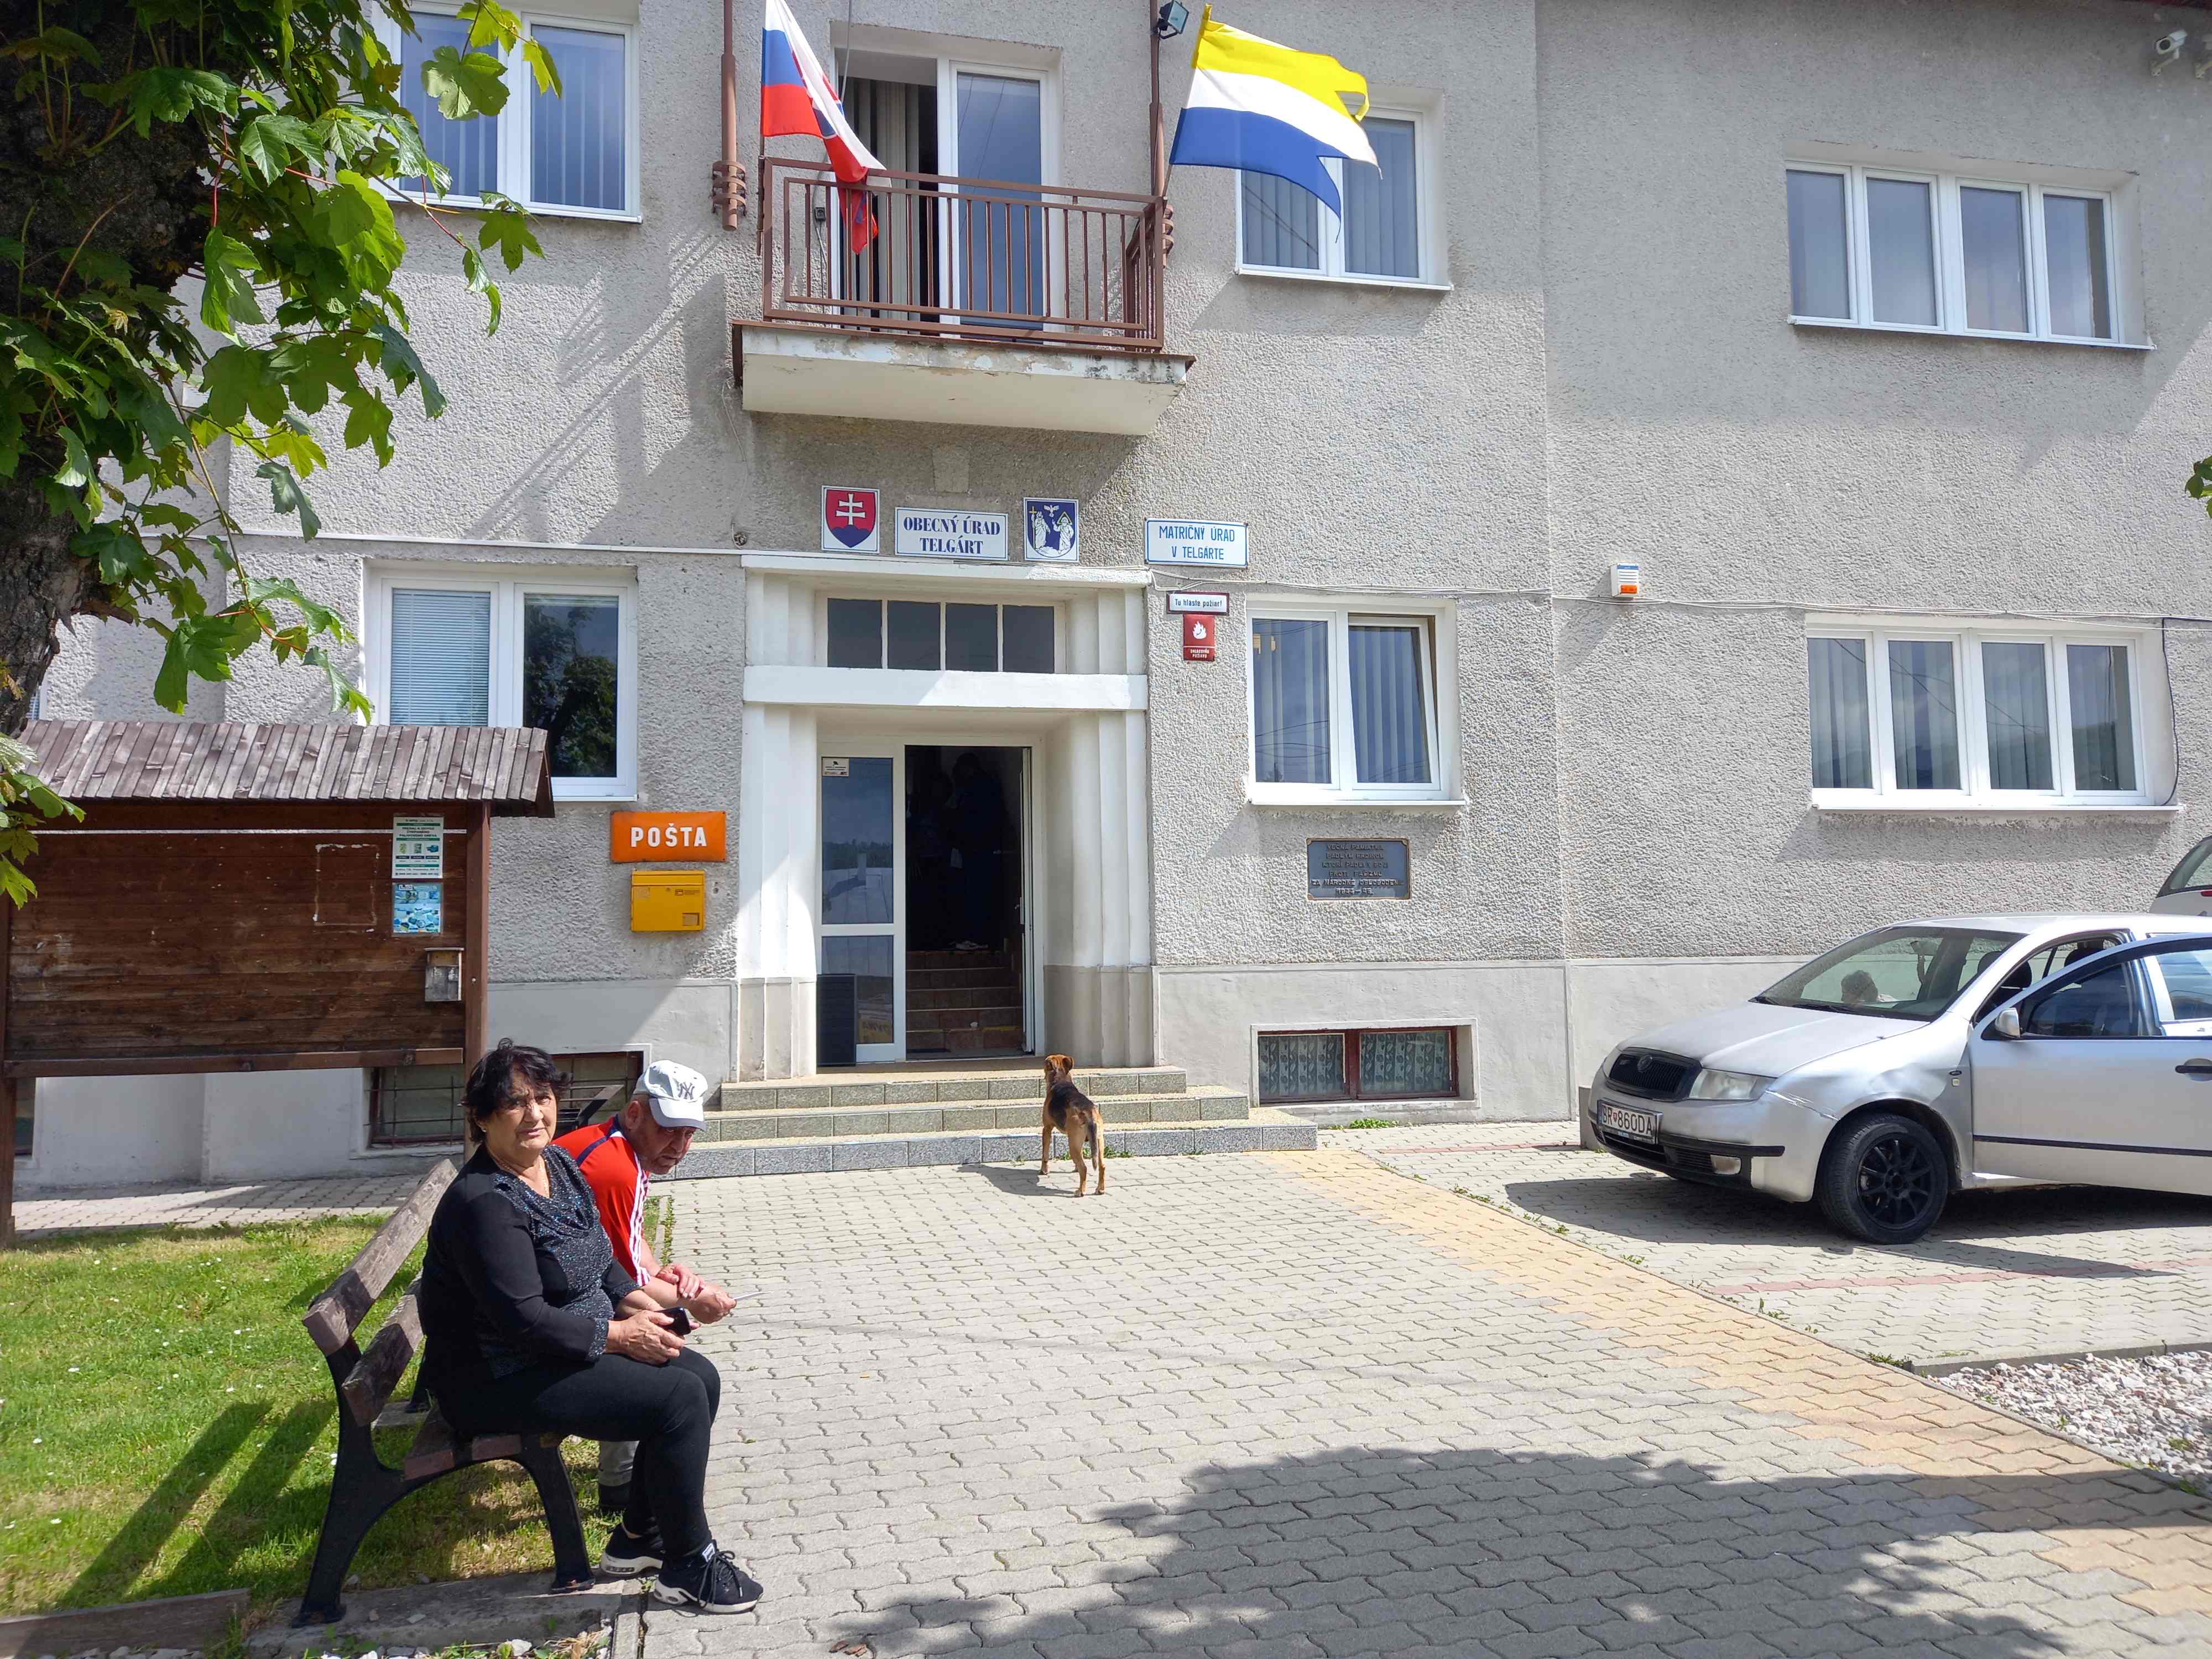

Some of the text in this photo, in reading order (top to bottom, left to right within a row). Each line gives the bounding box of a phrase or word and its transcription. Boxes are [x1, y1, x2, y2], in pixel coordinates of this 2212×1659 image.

[903, 515, 1000, 535] OBECNÝ ÚRAD
[1159, 525, 1235, 542] MATRIČNÝ ÚRAD
[919, 535, 983, 554] TELGÁRT
[1171, 546, 1224, 560] V TELGÁRTE
[630, 823, 707, 847] POŠTA
[678, 1081, 695, 1100] NY
